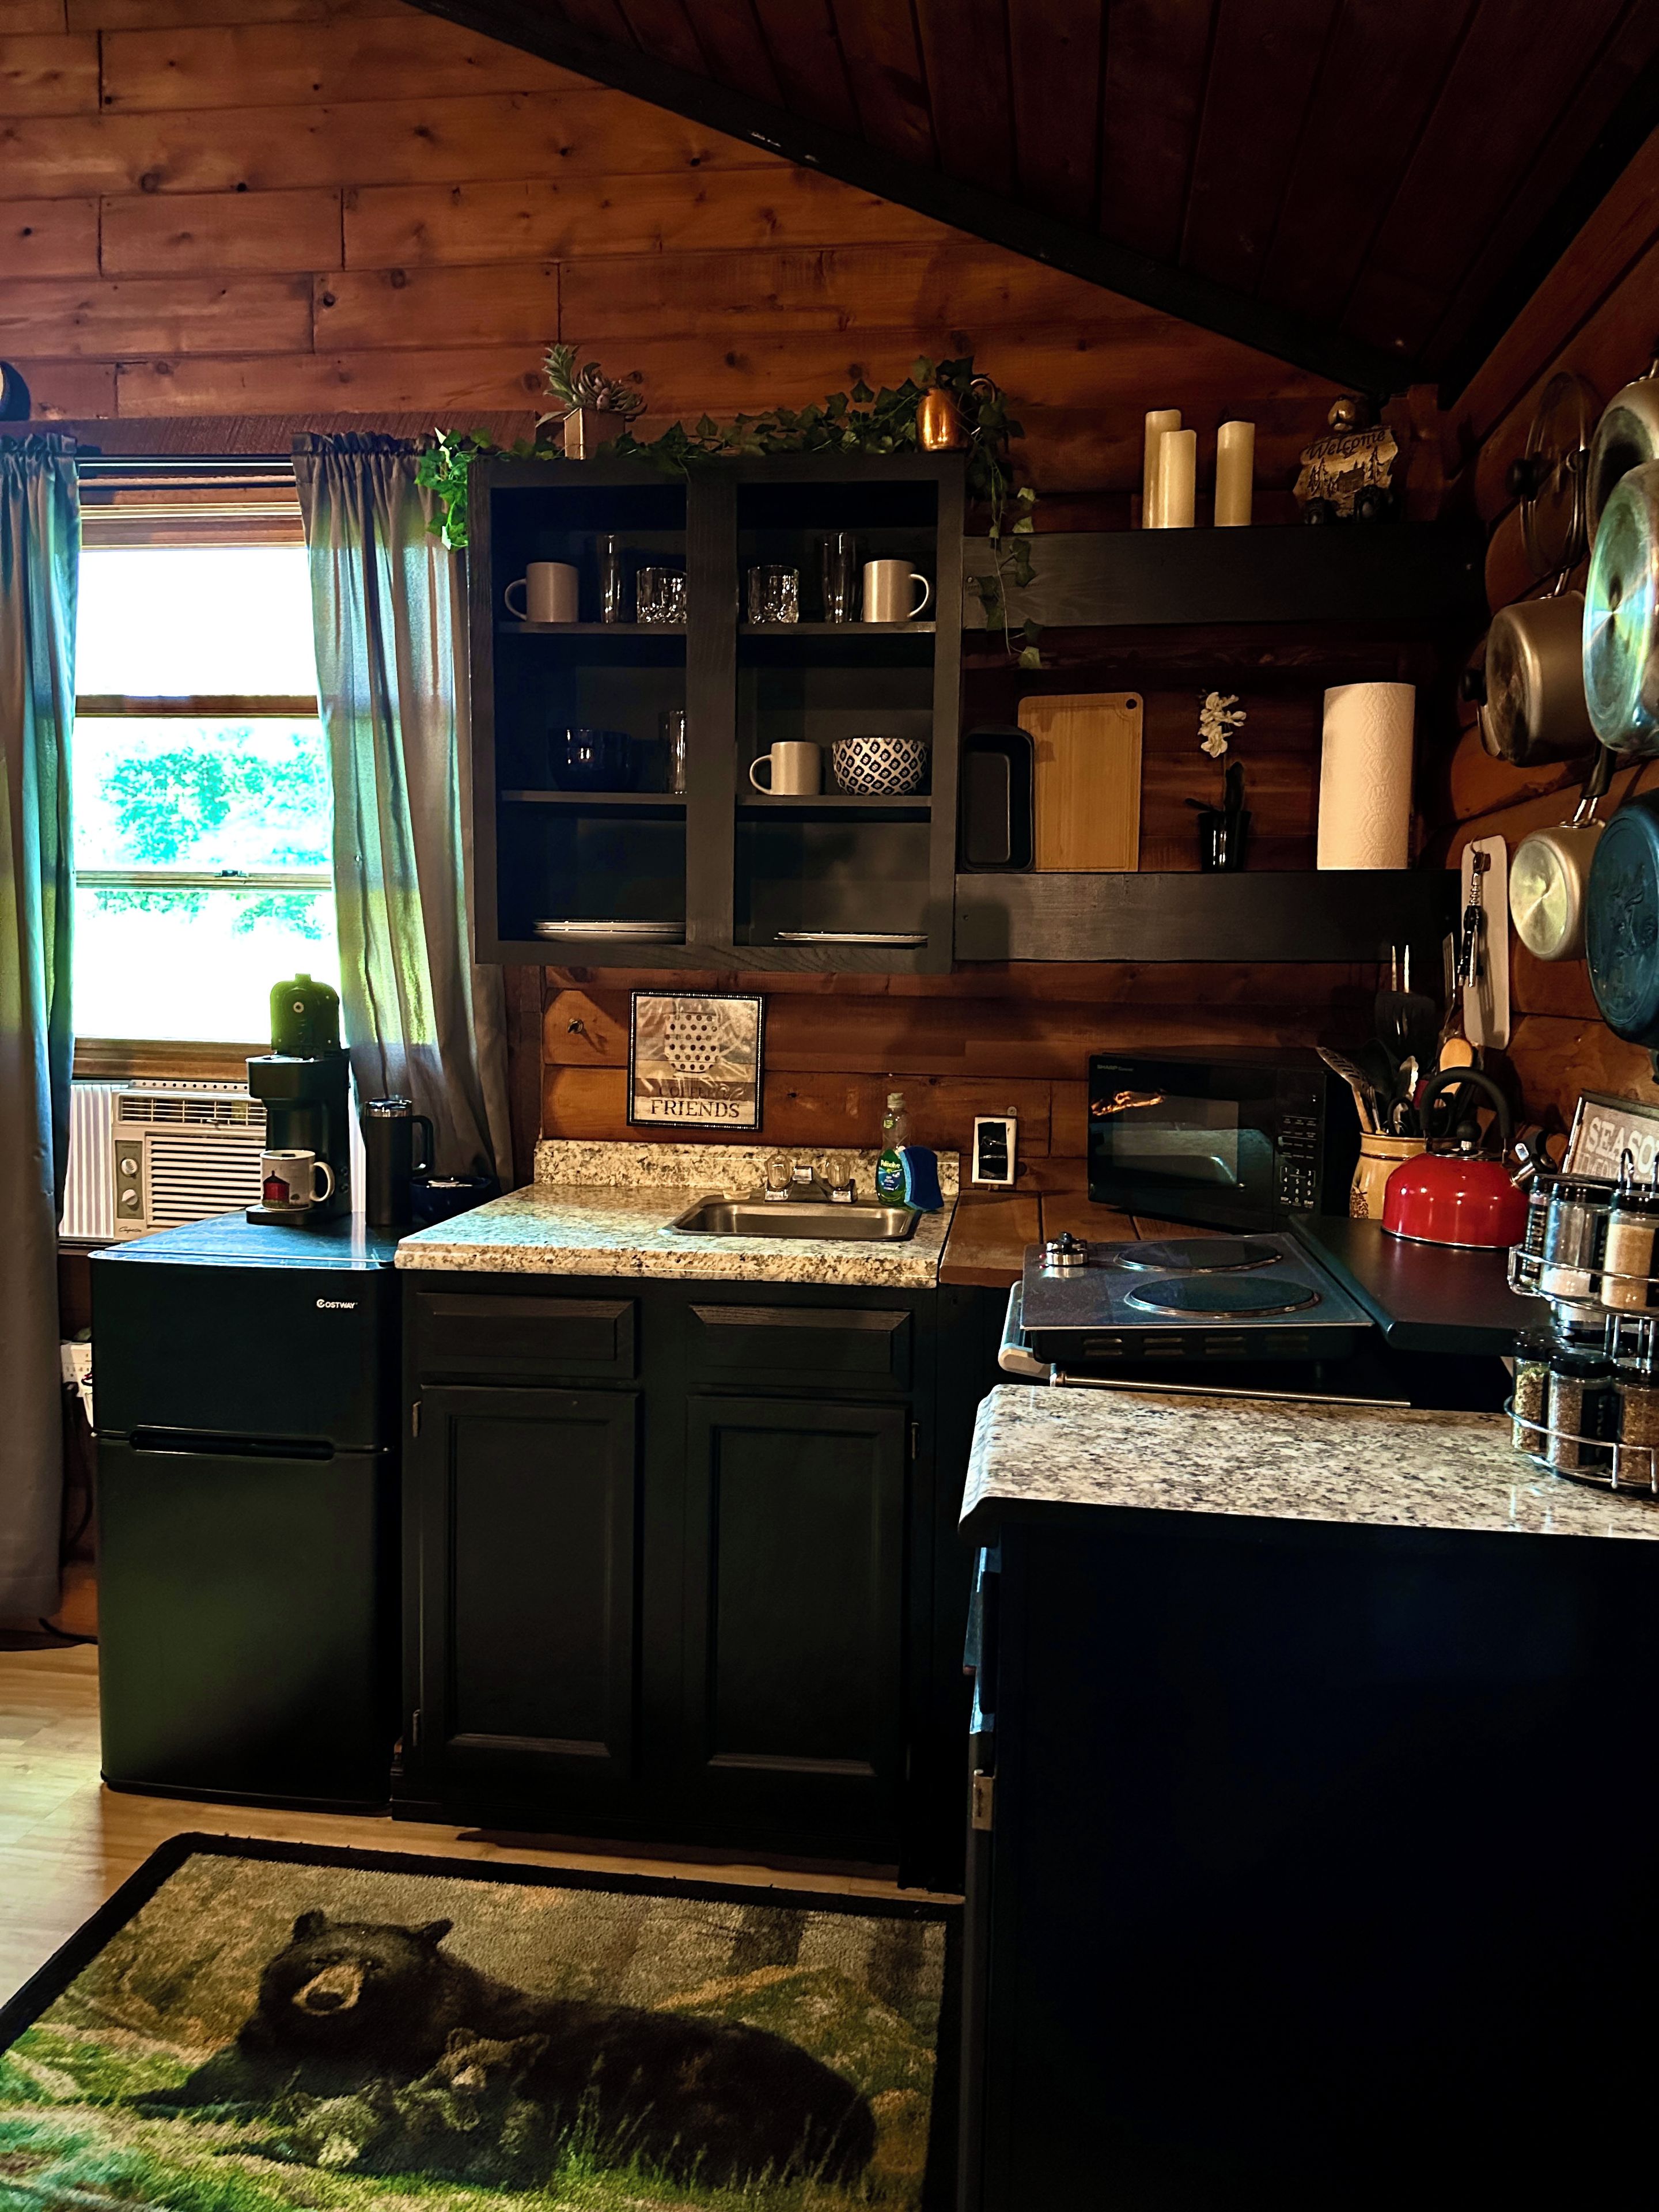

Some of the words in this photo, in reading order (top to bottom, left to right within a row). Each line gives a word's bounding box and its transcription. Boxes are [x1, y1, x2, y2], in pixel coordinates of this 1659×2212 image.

[1306, 430, 1385, 460] Welcome
[650, 1099, 740, 1118] FRIENDS
[1585, 1116, 1659, 1173] SEASO
[881, 1160, 900, 1168] Palmolive
[316, 1298, 355, 1309] COSTWAY
